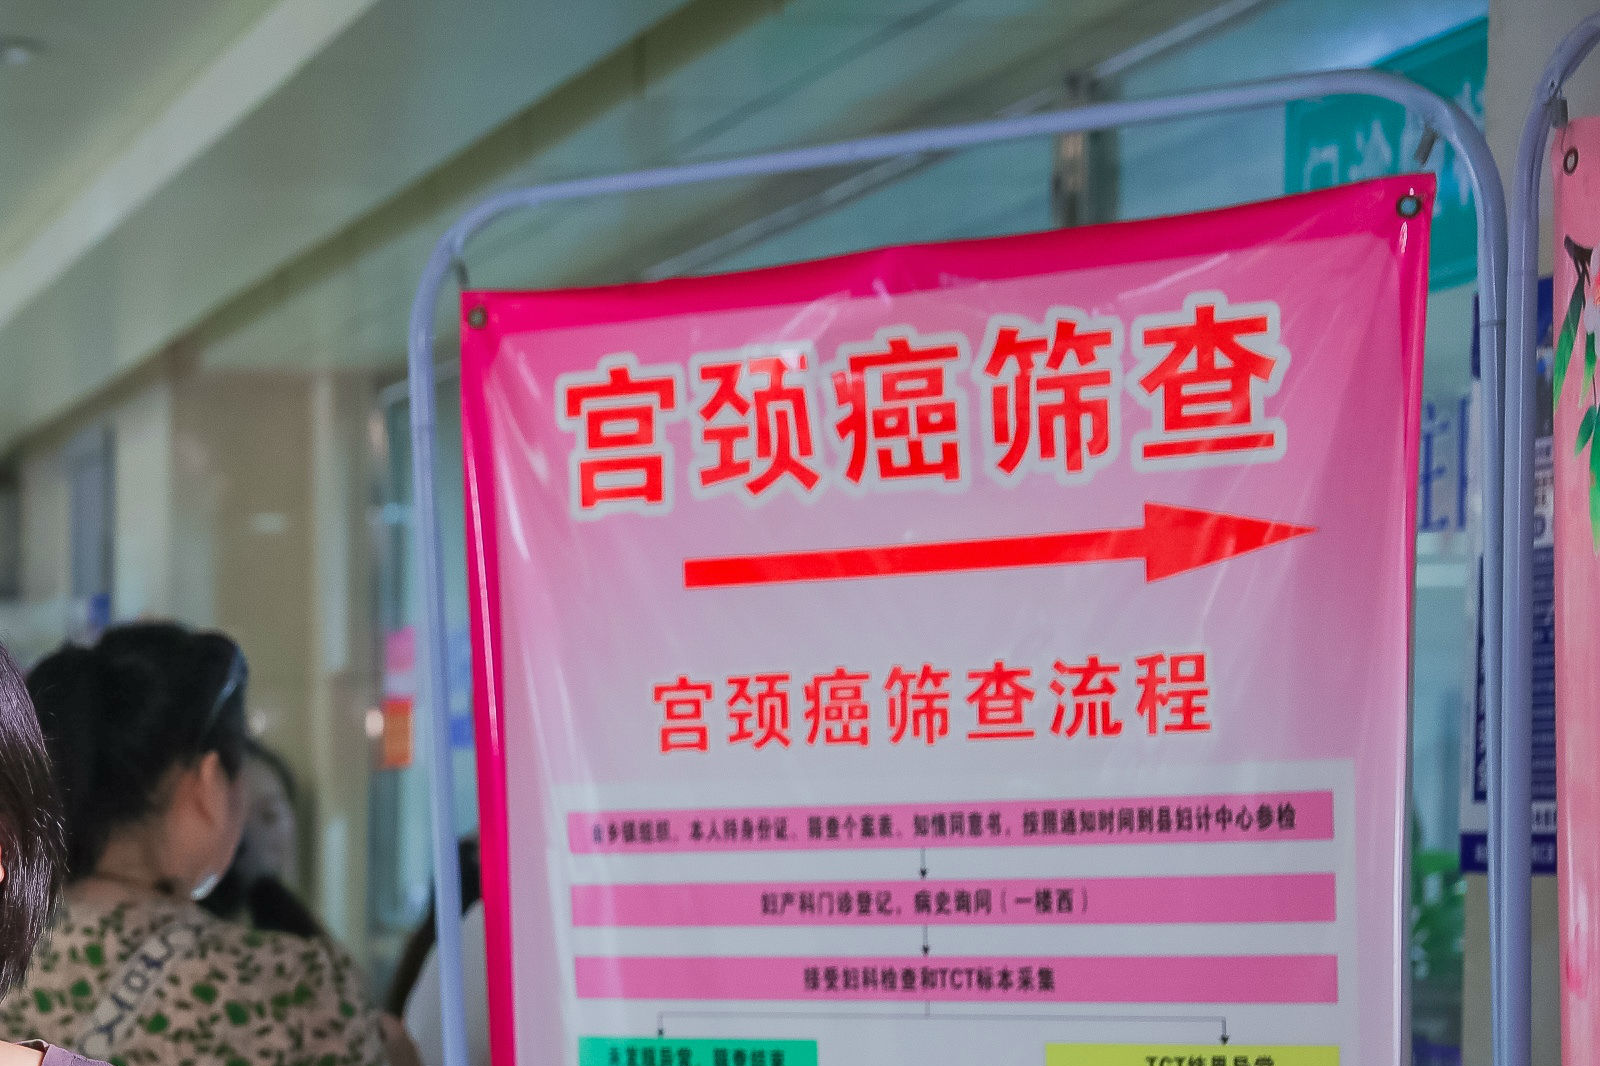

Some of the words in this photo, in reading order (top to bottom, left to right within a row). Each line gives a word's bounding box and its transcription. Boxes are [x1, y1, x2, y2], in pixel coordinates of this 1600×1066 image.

[563, 302, 1276, 510] 宫颈癌筛查
[653, 652, 1211, 752] 宫颈癌筛查流程
